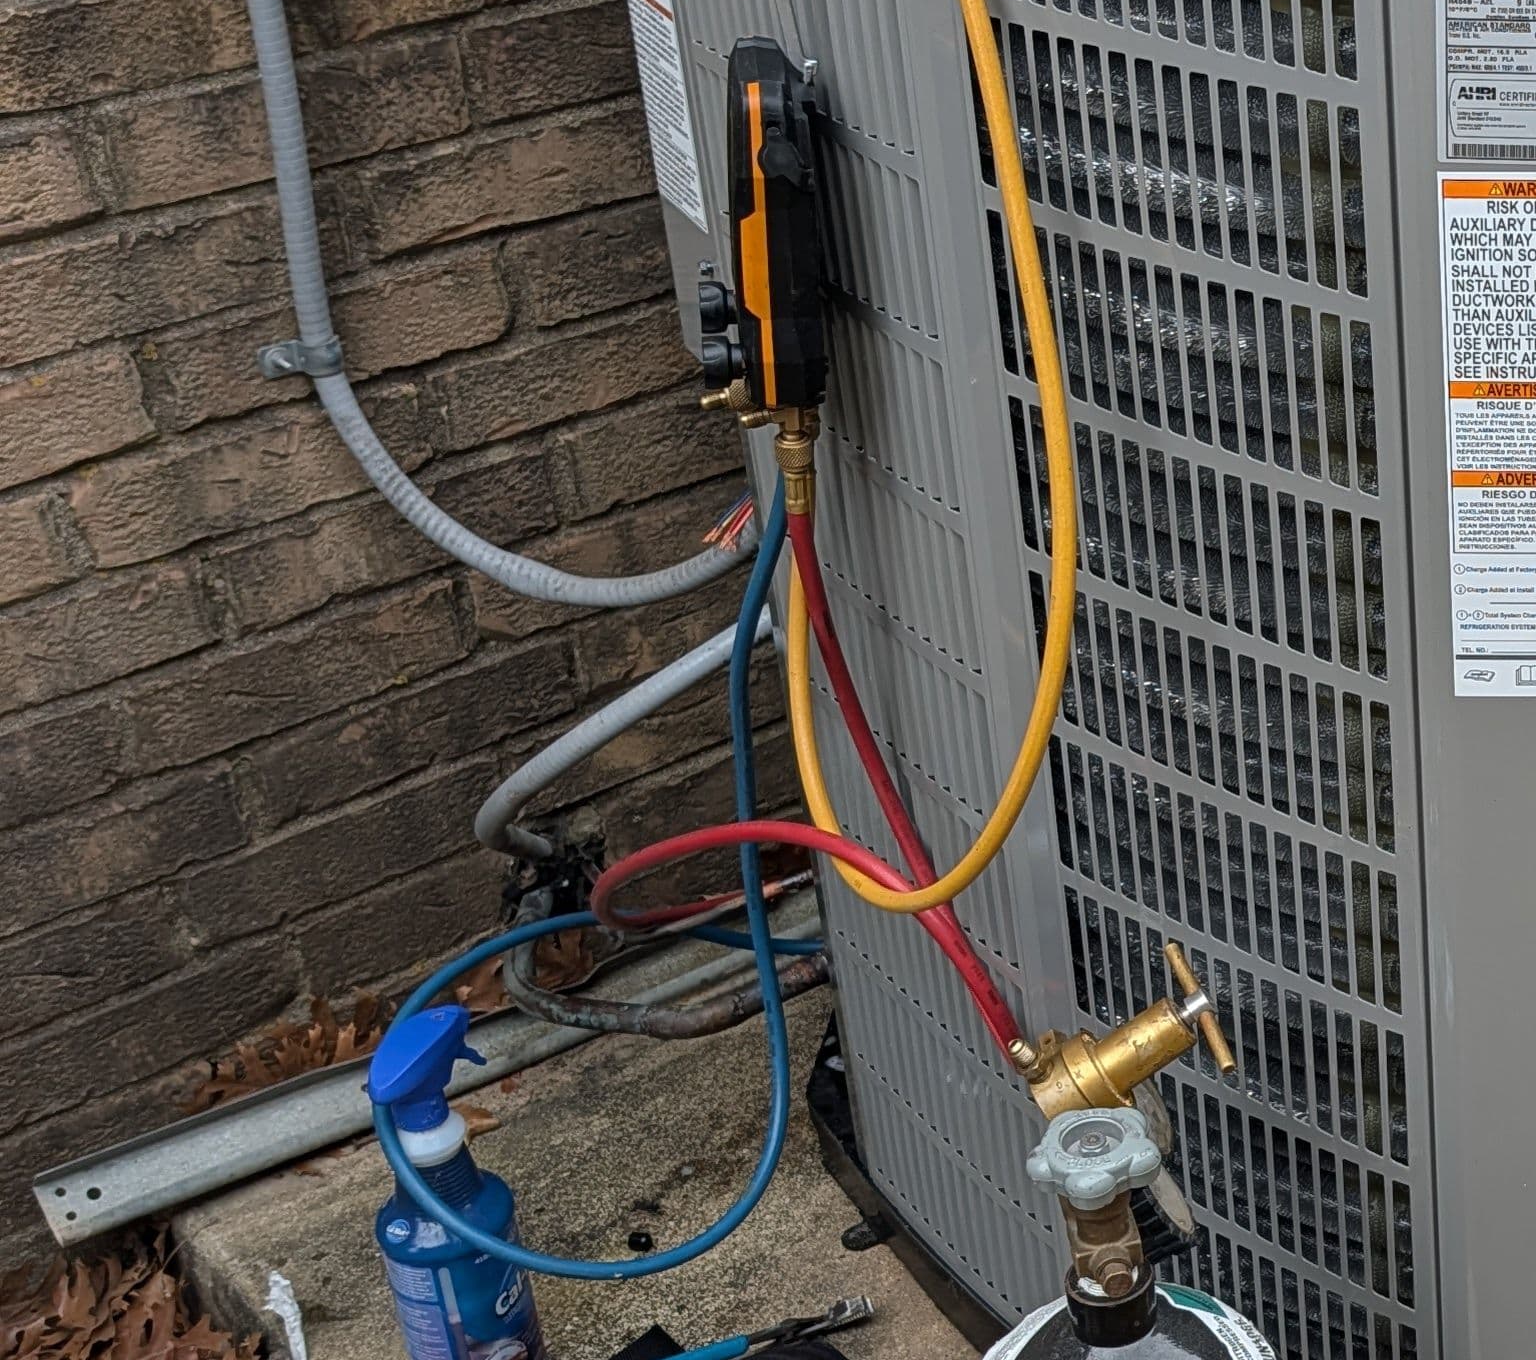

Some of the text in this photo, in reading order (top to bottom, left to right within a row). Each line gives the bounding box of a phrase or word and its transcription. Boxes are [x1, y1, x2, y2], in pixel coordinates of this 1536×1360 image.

[1458, 87, 1496, 100] AHRI
[1487, 201, 1519, 214] RISK
[1450, 218, 1526, 232] AUXILIARY
[1450, 233, 1498, 247] WHICH
[1502, 233, 1533, 247] MAY
[1451, 248, 1514, 262] IGNITION
[1451, 265, 1498, 278] SHALL
[1502, 265, 1532, 278] NOT
[1452, 279, 1529, 293] INSTALLED
[1453, 309, 1491, 322] THAN
[1453, 323, 1514, 336] DEVICES
[1454, 338, 1481, 350] USE
[1486, 338, 1520, 351] WITH
[1454, 352, 1518, 365] SPECIFIC
[1454, 366, 1481, 379] SEE
[1477, 401, 1521, 411] RISQUE
[1482, 490, 1526, 498] RIESGO
